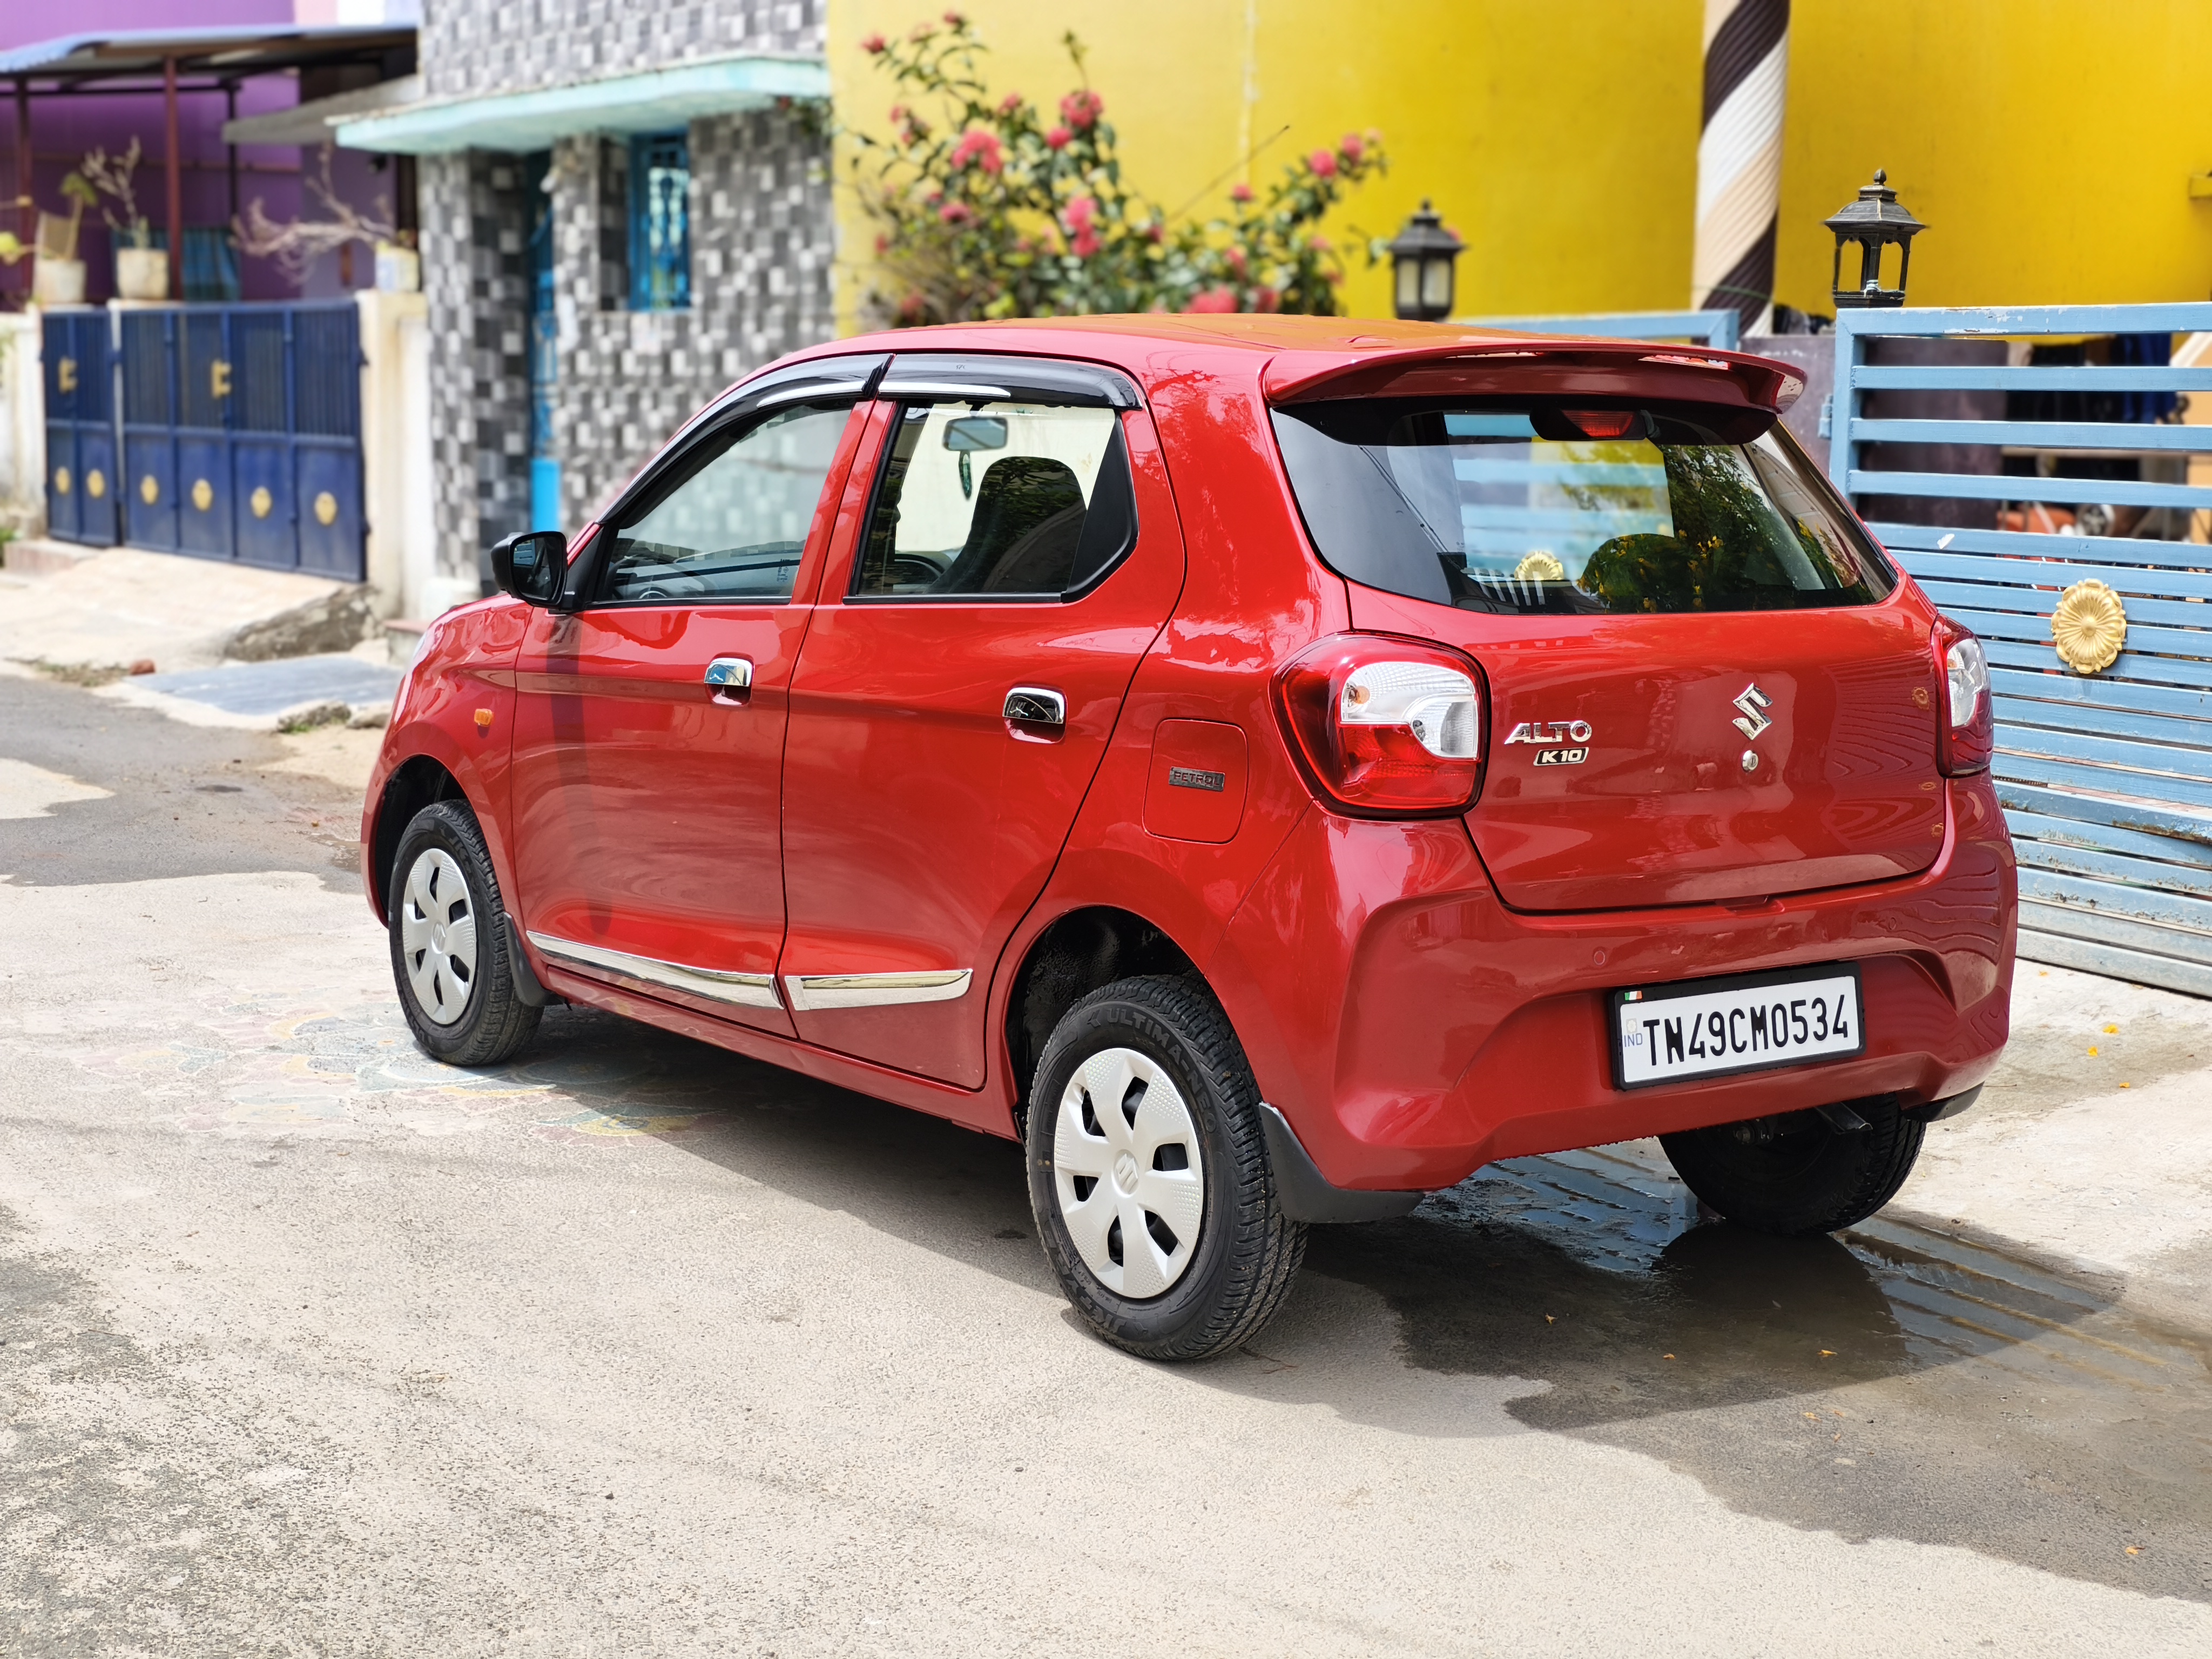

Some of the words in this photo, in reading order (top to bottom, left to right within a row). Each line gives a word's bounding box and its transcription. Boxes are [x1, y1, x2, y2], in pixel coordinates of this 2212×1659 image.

[1504, 720, 1592, 745] ALTO
[1541, 748, 1582, 764] K10
[1174, 771, 1220, 786] PETROL
[1642, 994, 1849, 1067] TN49CM0534
[1624, 1032, 1643, 1048] IND
